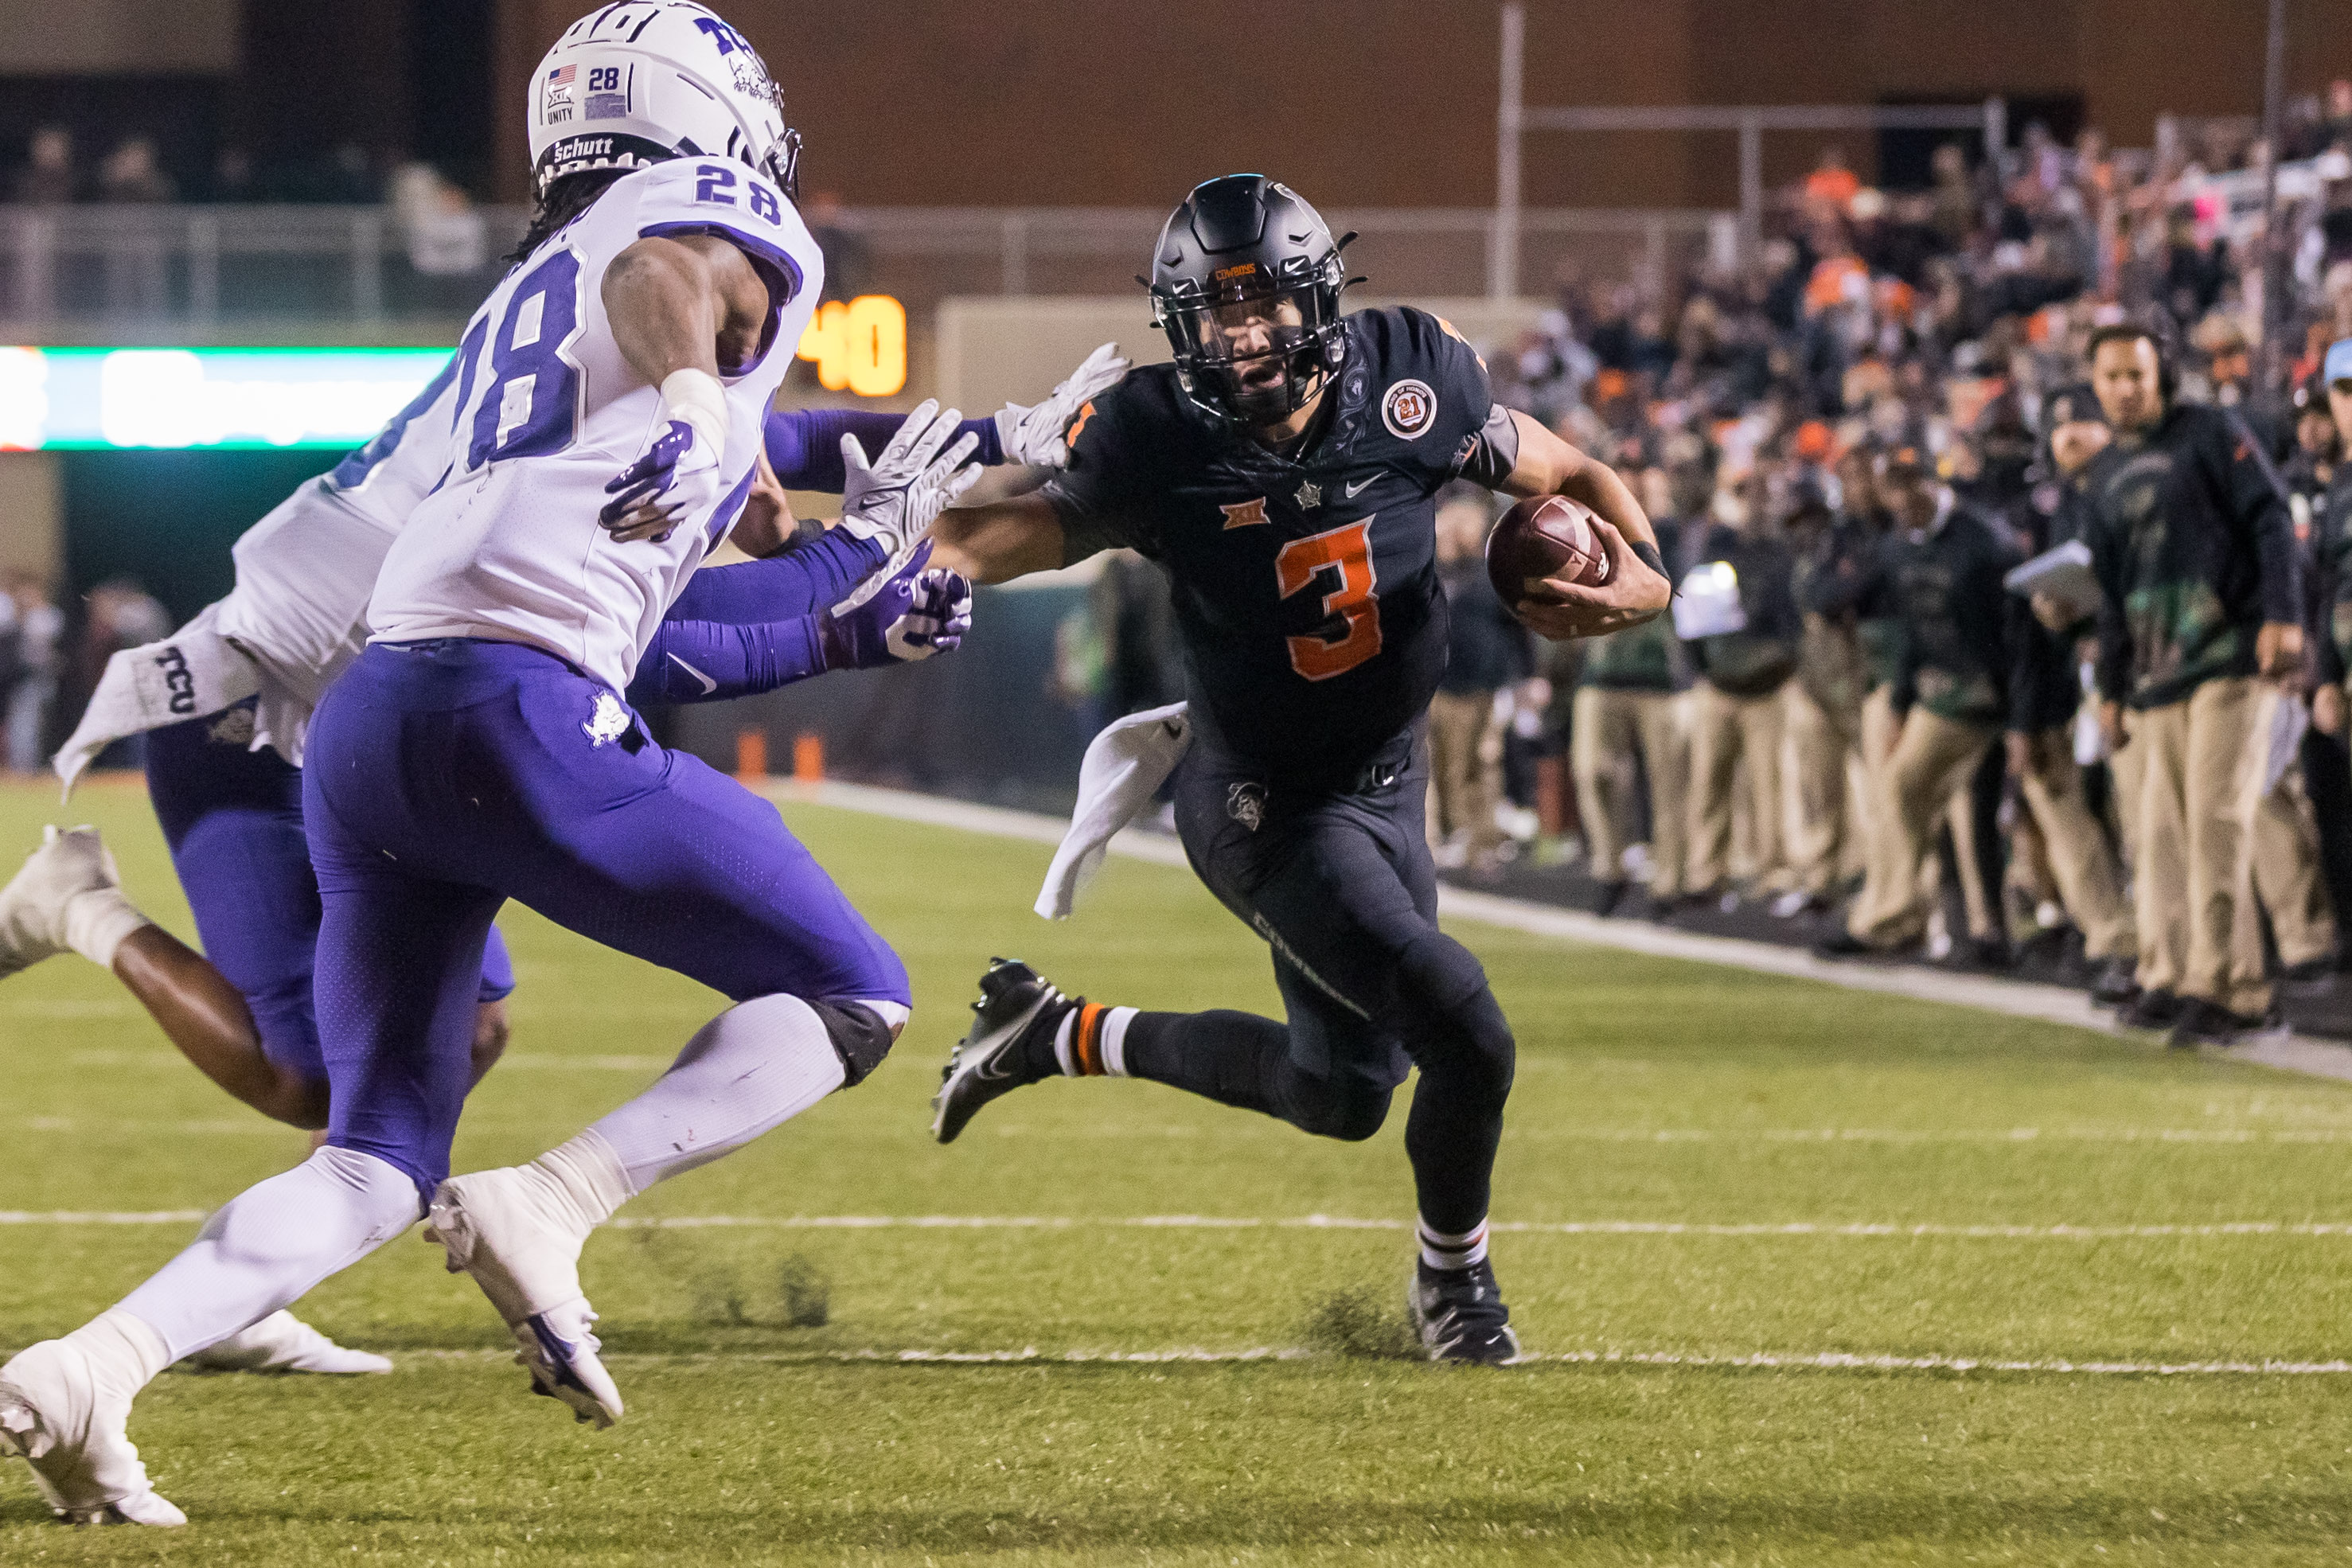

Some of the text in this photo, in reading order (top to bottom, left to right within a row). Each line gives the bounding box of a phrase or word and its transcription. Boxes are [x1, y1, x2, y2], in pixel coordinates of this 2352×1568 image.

[589, 68, 619, 92] 28
[548, 107, 572, 125] UNITY
[696, 164, 782, 227] 28
[1215, 263, 1256, 281] COWBOYS
[796, 294, 907, 397] 40
[1398, 396, 1421, 419] 21
[1275, 513, 1383, 682] 3
[154, 646, 196, 714] TCU
